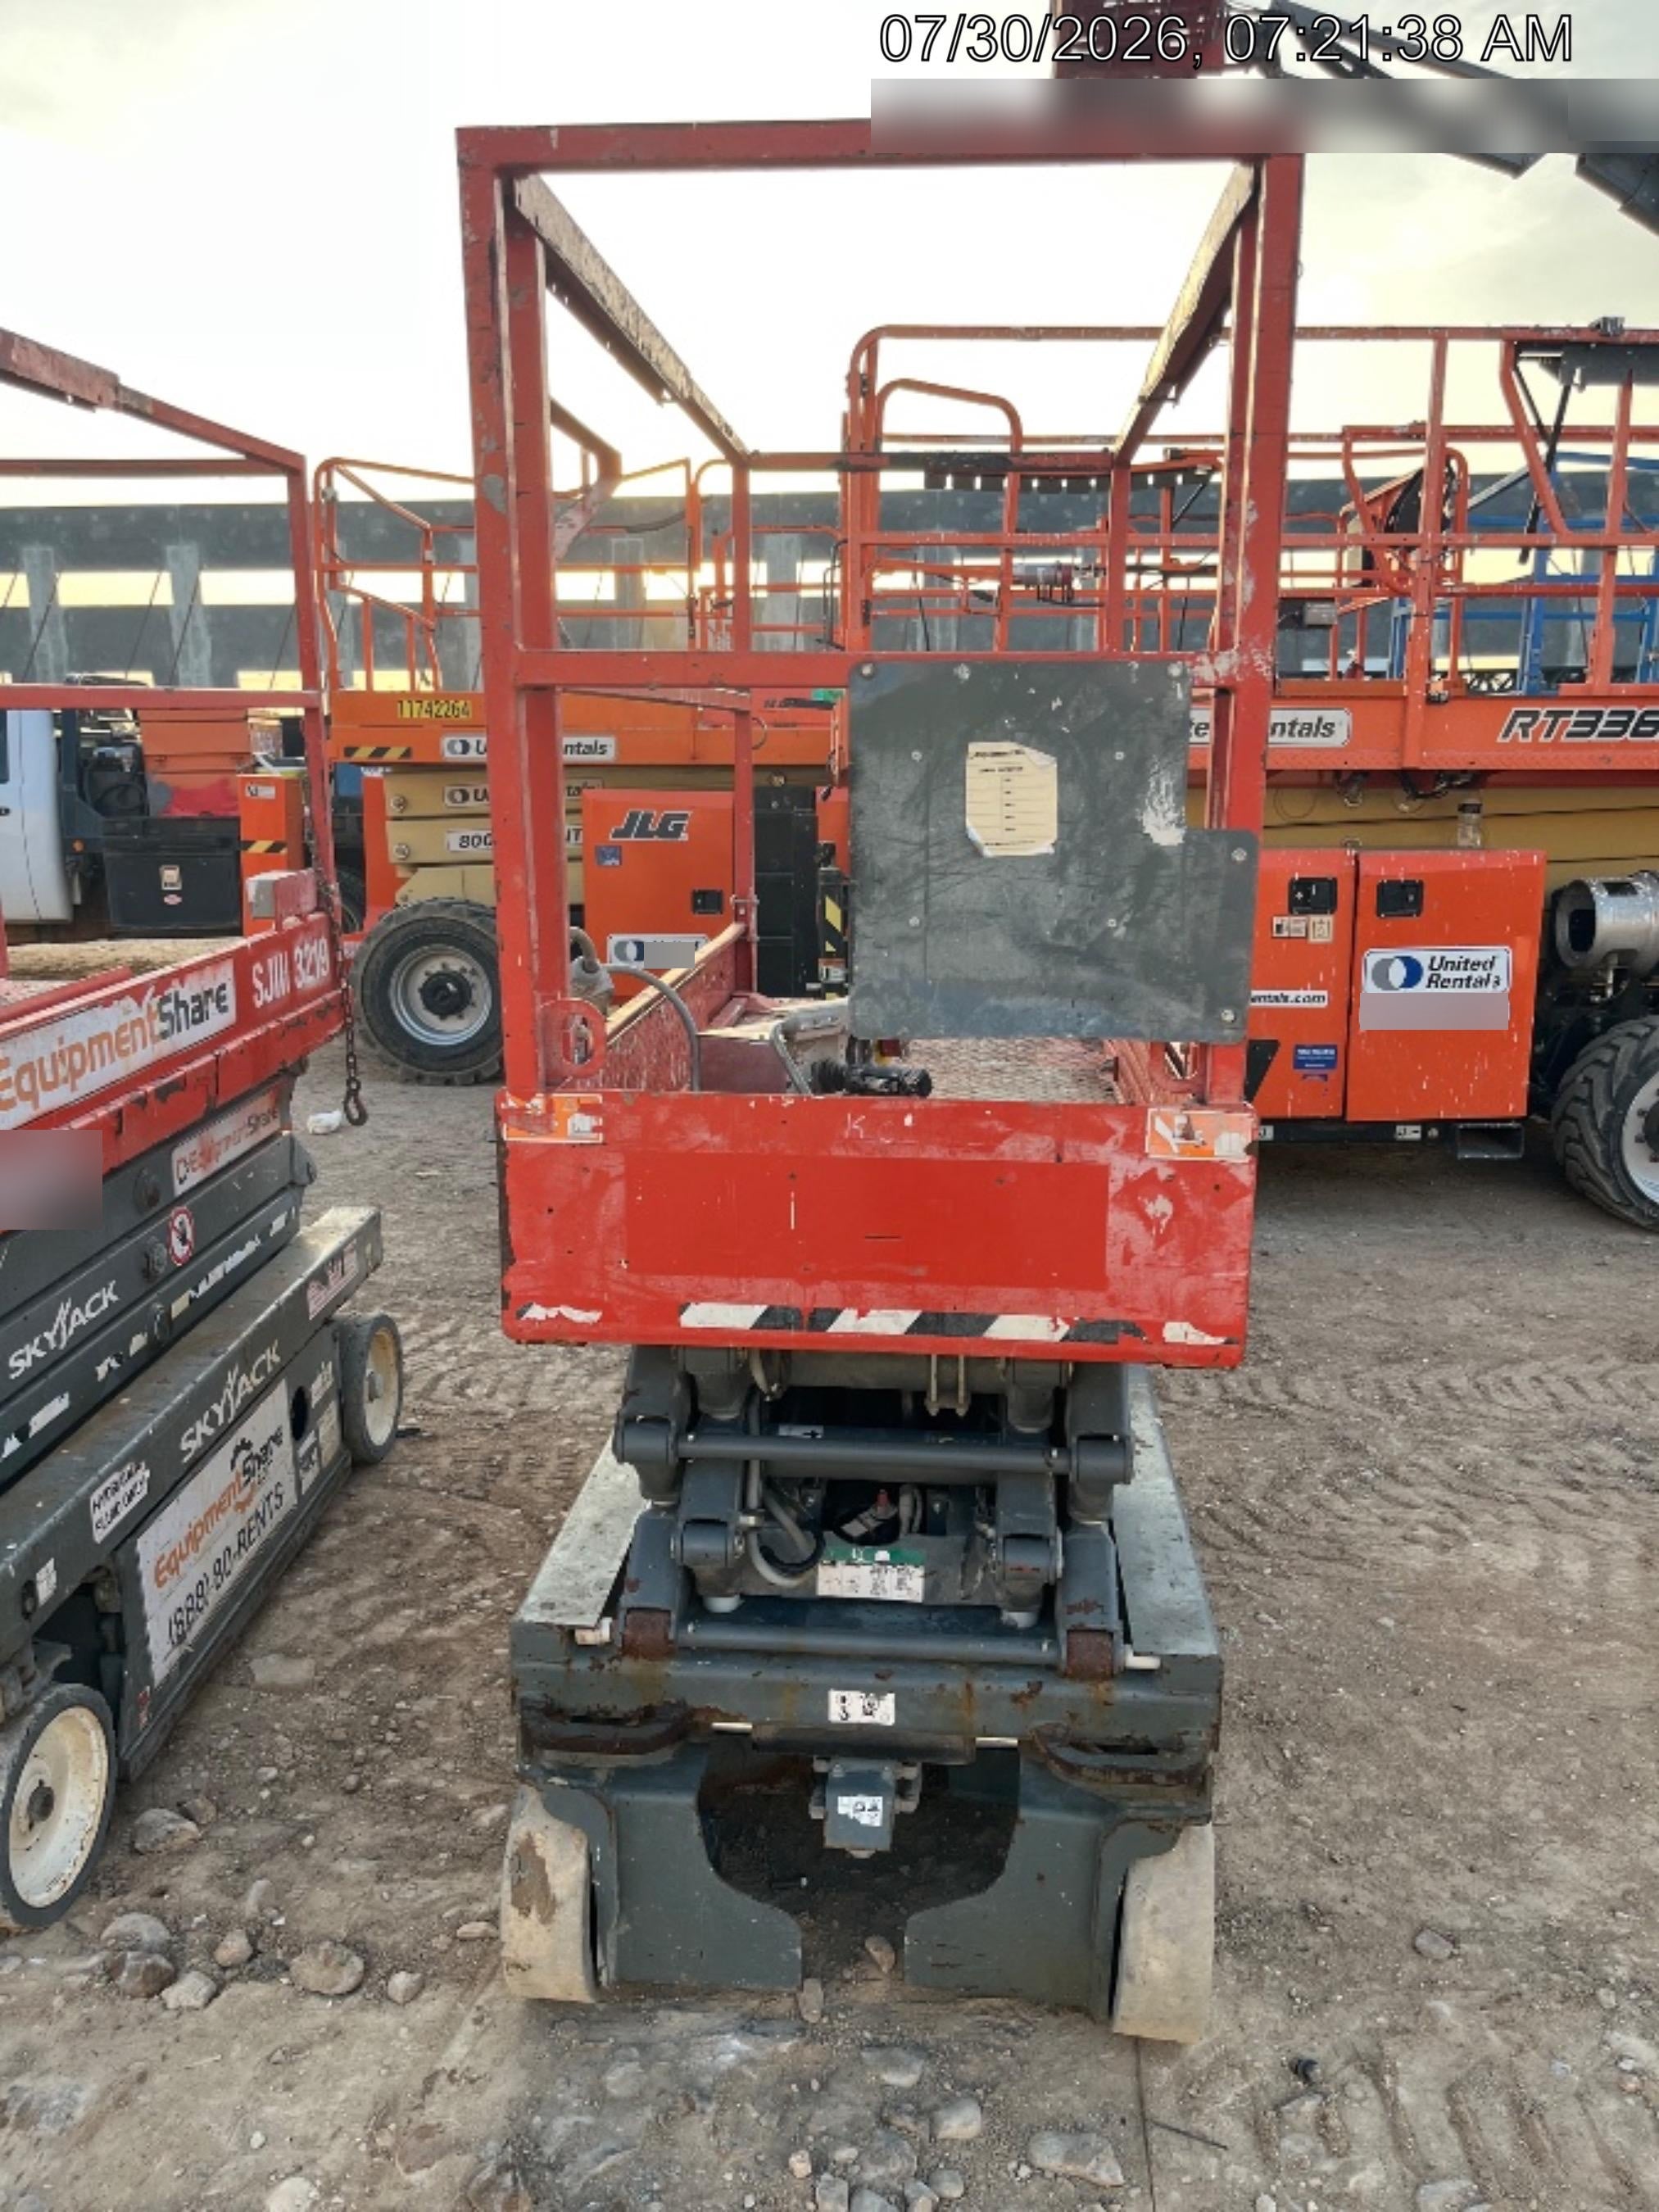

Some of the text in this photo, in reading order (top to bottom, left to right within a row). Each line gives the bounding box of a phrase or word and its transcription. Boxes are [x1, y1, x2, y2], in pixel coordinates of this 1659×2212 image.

[397, 700, 471, 718] 11742264
[1270, 714, 1336, 739] ntals
[563, 737, 609, 756] ntals
[610, 810, 691, 841] JLG
[293, 935, 329, 990] 3219
[1428, 954, 1499, 972] United
[1426, 972, 1502, 989] Rentals
[8, 1279, 121, 1380] SKYJACK
[179, 1338, 281, 1464] SKYJACK
